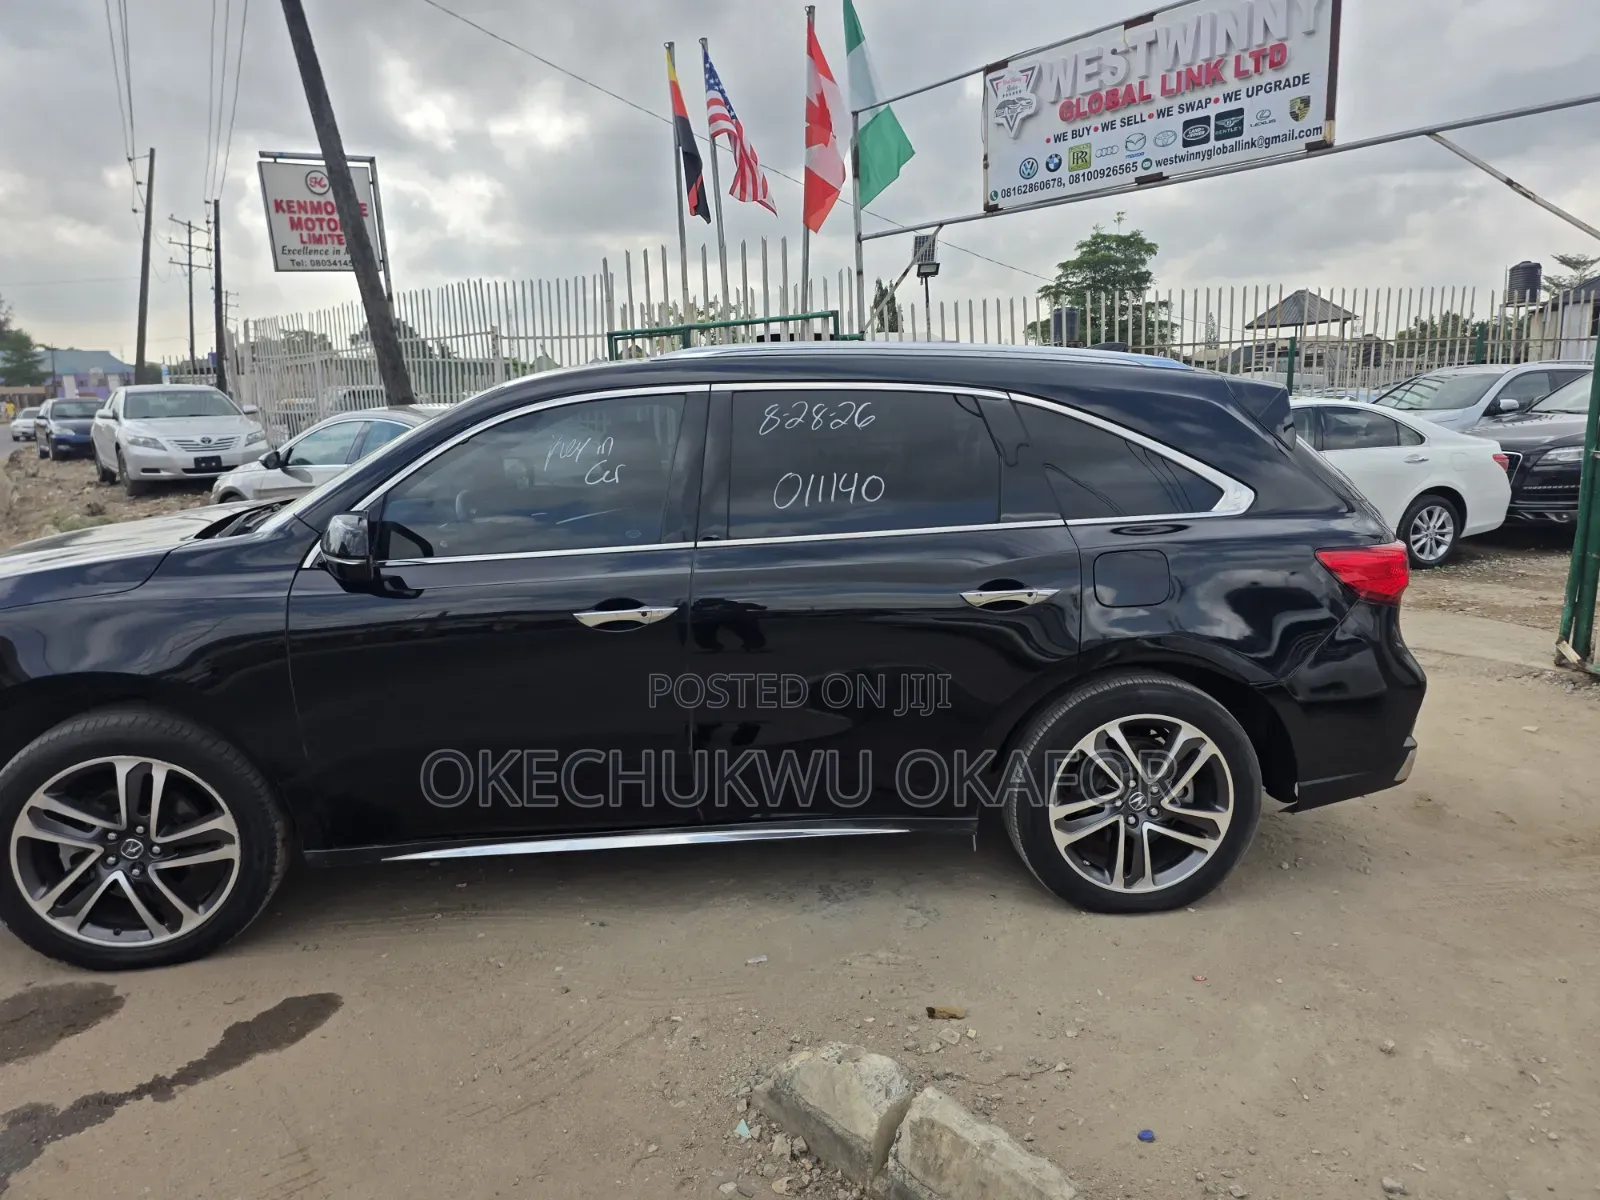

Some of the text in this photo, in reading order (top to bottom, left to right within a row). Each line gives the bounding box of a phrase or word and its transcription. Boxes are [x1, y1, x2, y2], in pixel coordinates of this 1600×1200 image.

[1040, 0, 1323, 102] WESTWINNY
[1058, 42, 1288, 122] GLOBAL LINK LTD
[1053, 72, 1310, 144] WE BUY WE SELL WE SWAP WE UPGRADE
[1001, 126, 1322, 198] 08162860678, 08100926565 westwinnygloballink@gmail.com
[274, 199, 369, 217] KENMOE
[289, 216, 344, 232] MOTO
[281, 245, 329, 256] Excellence
[332, 246, 341, 256] in
[300, 232, 346, 246] LIMITE
[773, 471, 885, 509] 011140
